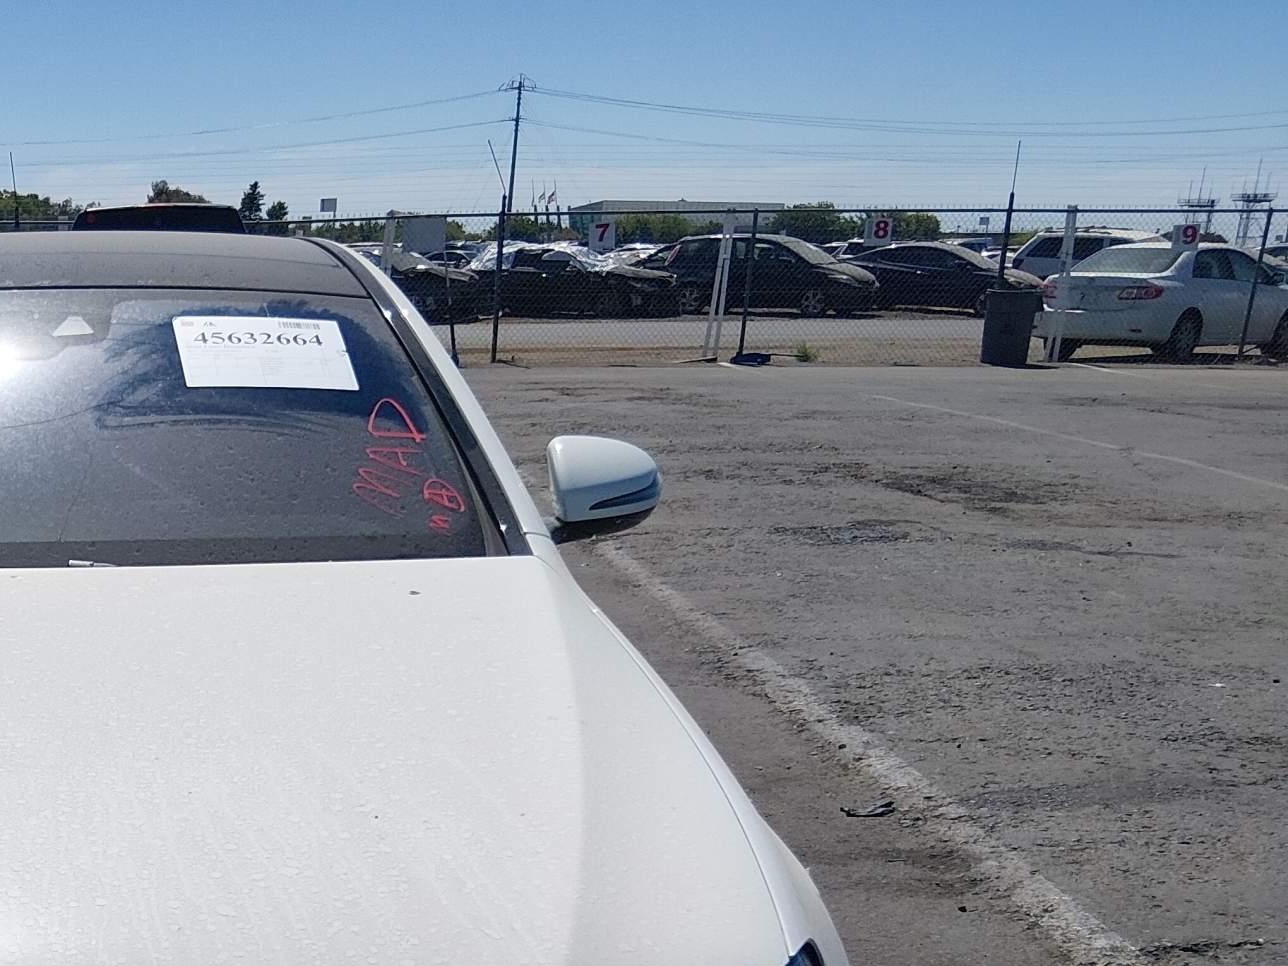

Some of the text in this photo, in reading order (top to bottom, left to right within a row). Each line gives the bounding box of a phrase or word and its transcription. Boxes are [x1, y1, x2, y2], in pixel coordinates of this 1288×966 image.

[595, 223, 610, 242] 7
[874, 220, 889, 239] 8
[1182, 225, 1197, 245] 9
[193, 331, 323, 347] 45632664
